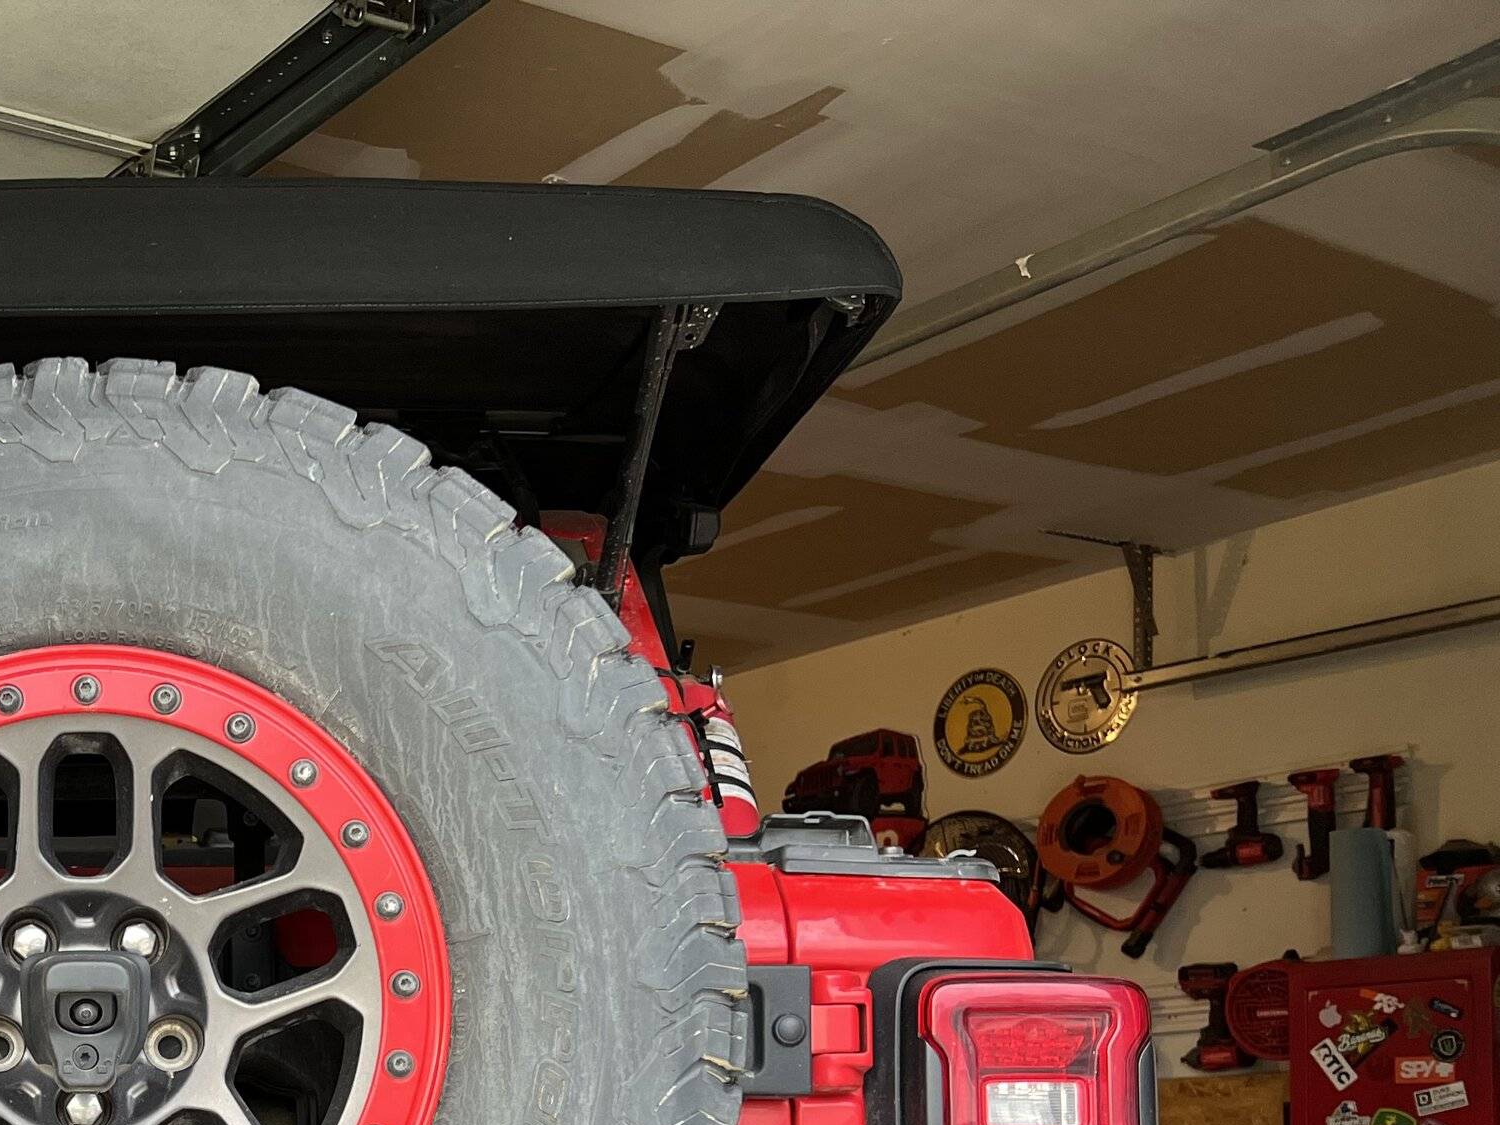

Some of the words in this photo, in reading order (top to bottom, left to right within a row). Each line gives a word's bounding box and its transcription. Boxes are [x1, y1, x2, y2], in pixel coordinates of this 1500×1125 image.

[61, 630, 110, 643] LOAD
[1056, 643, 1114, 670] GLOCK
[937, 675, 974, 718] LIBERTY
[986, 672, 1018, 697] DEATH
[964, 757, 999, 775] TREAD
[999, 741, 1015, 760] ON
[1011, 719, 1023, 741] ME
